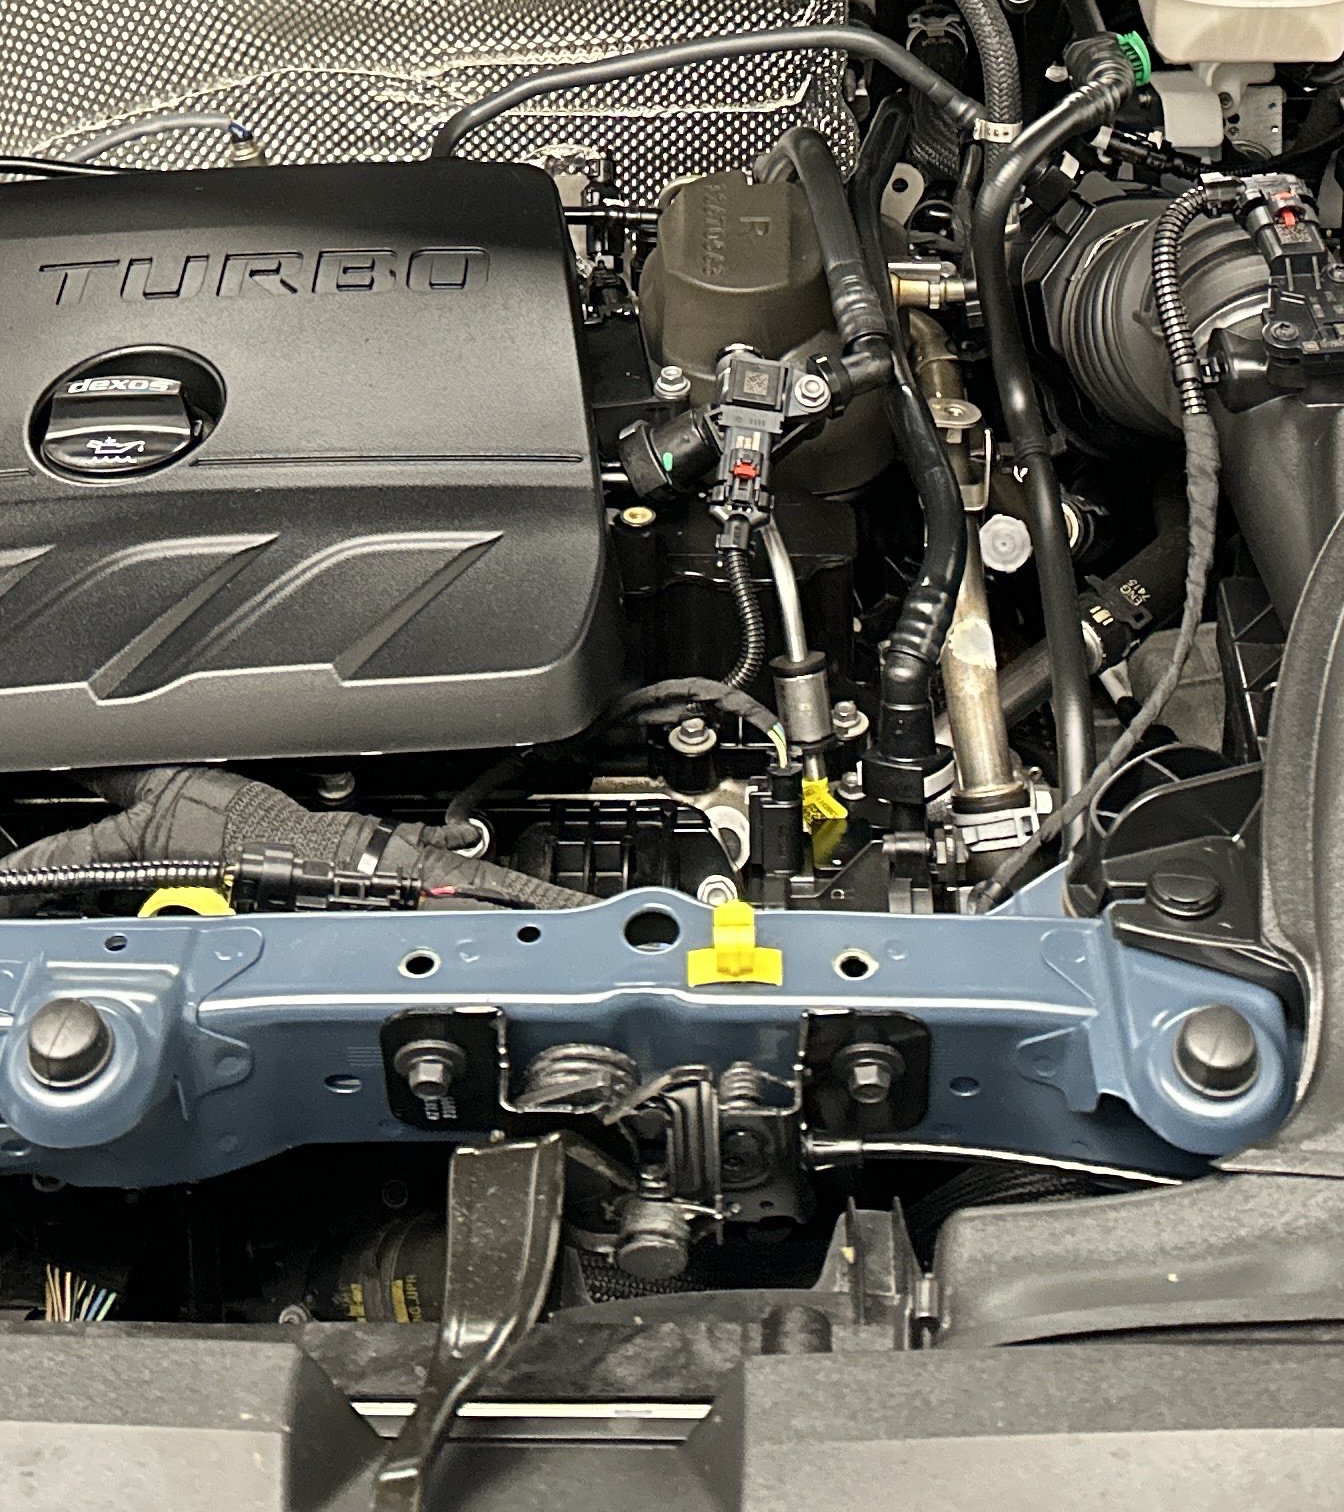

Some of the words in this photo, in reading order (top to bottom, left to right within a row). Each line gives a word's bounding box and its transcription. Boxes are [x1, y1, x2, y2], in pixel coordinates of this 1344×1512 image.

[37, 245, 492, 306] TURBO
[68, 374, 171, 396] dexos
[1120, 584, 1143, 606] ENG
